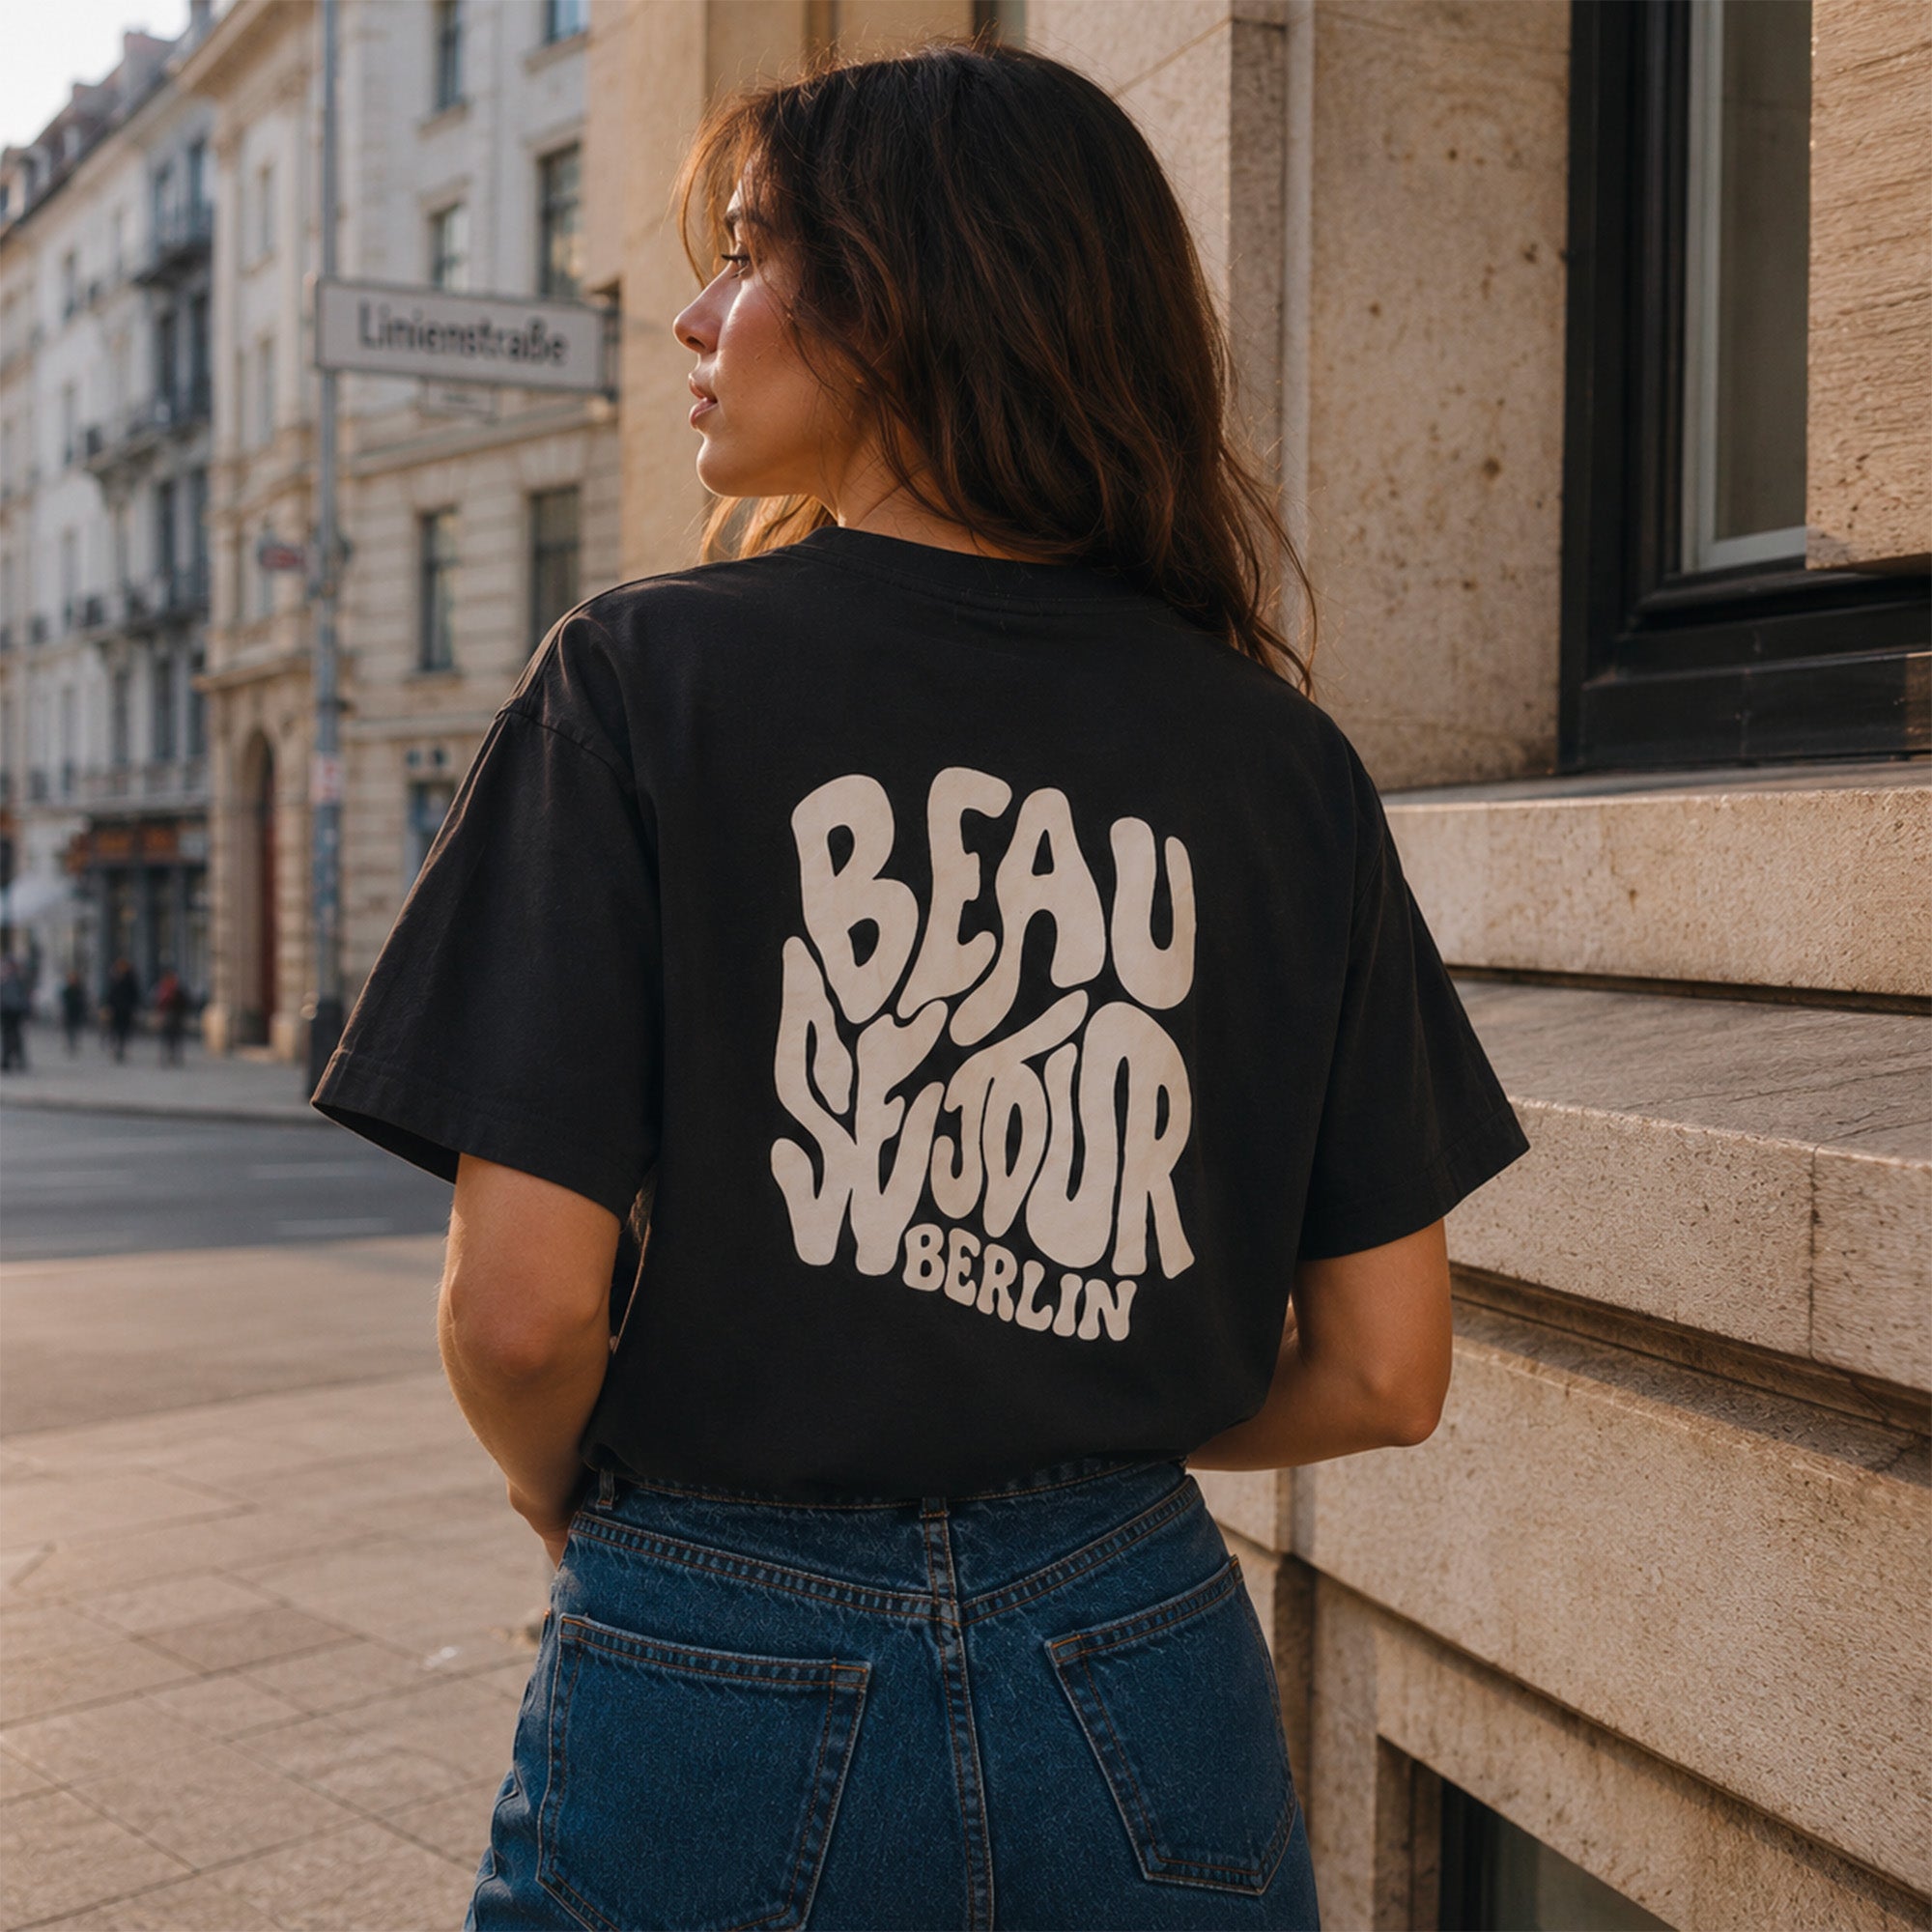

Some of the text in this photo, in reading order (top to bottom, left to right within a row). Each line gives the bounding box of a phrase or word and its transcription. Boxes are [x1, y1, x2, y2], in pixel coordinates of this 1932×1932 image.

[357, 300, 568, 366] Linienstraße
[791, 767, 1196, 1046] BEAU
[771, 936, 1194, 1279] SEJOUR
[902, 1224, 1137, 1341] BERLIN
